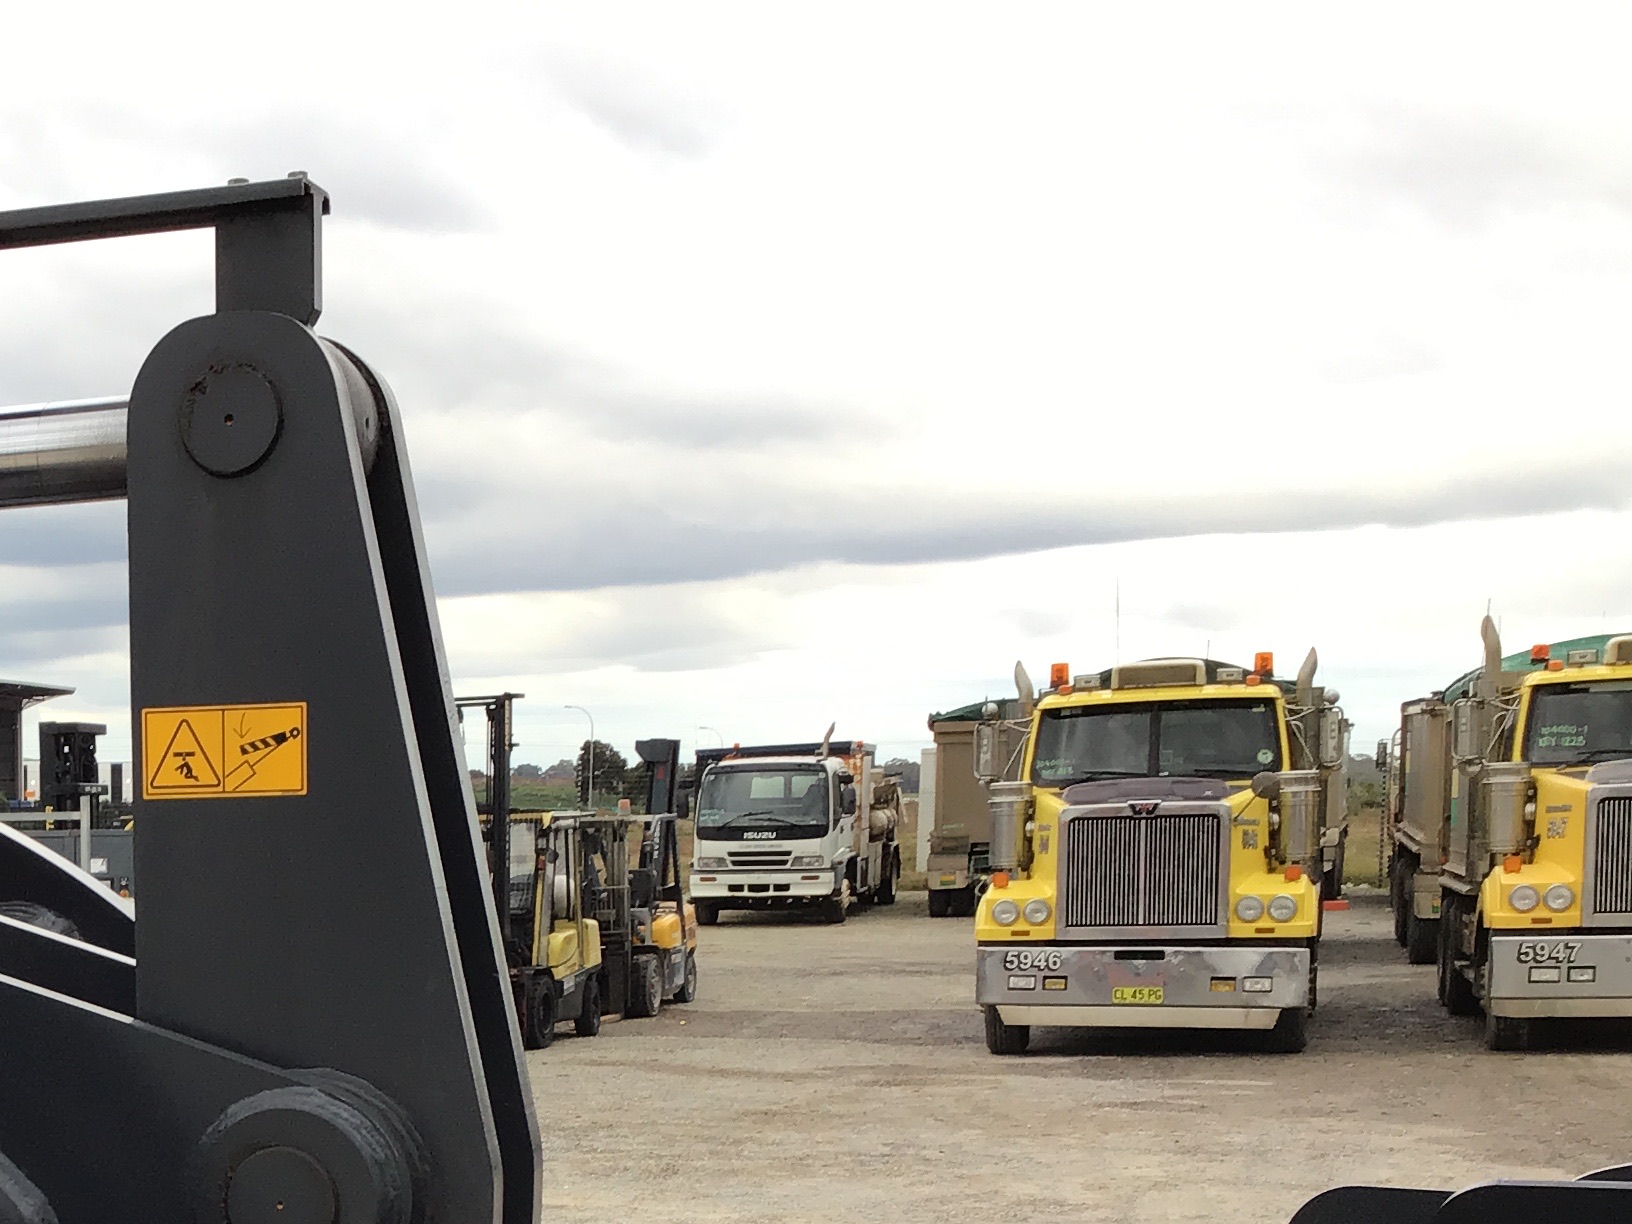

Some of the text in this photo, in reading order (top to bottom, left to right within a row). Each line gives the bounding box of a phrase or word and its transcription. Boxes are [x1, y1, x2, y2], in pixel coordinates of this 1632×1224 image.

[743, 831, 777, 839] ISUZU
[1004, 951, 1062, 971] 5946
[1516, 942, 1583, 964] 5947
[1113, 988, 1162, 1000] CL 45 PG
